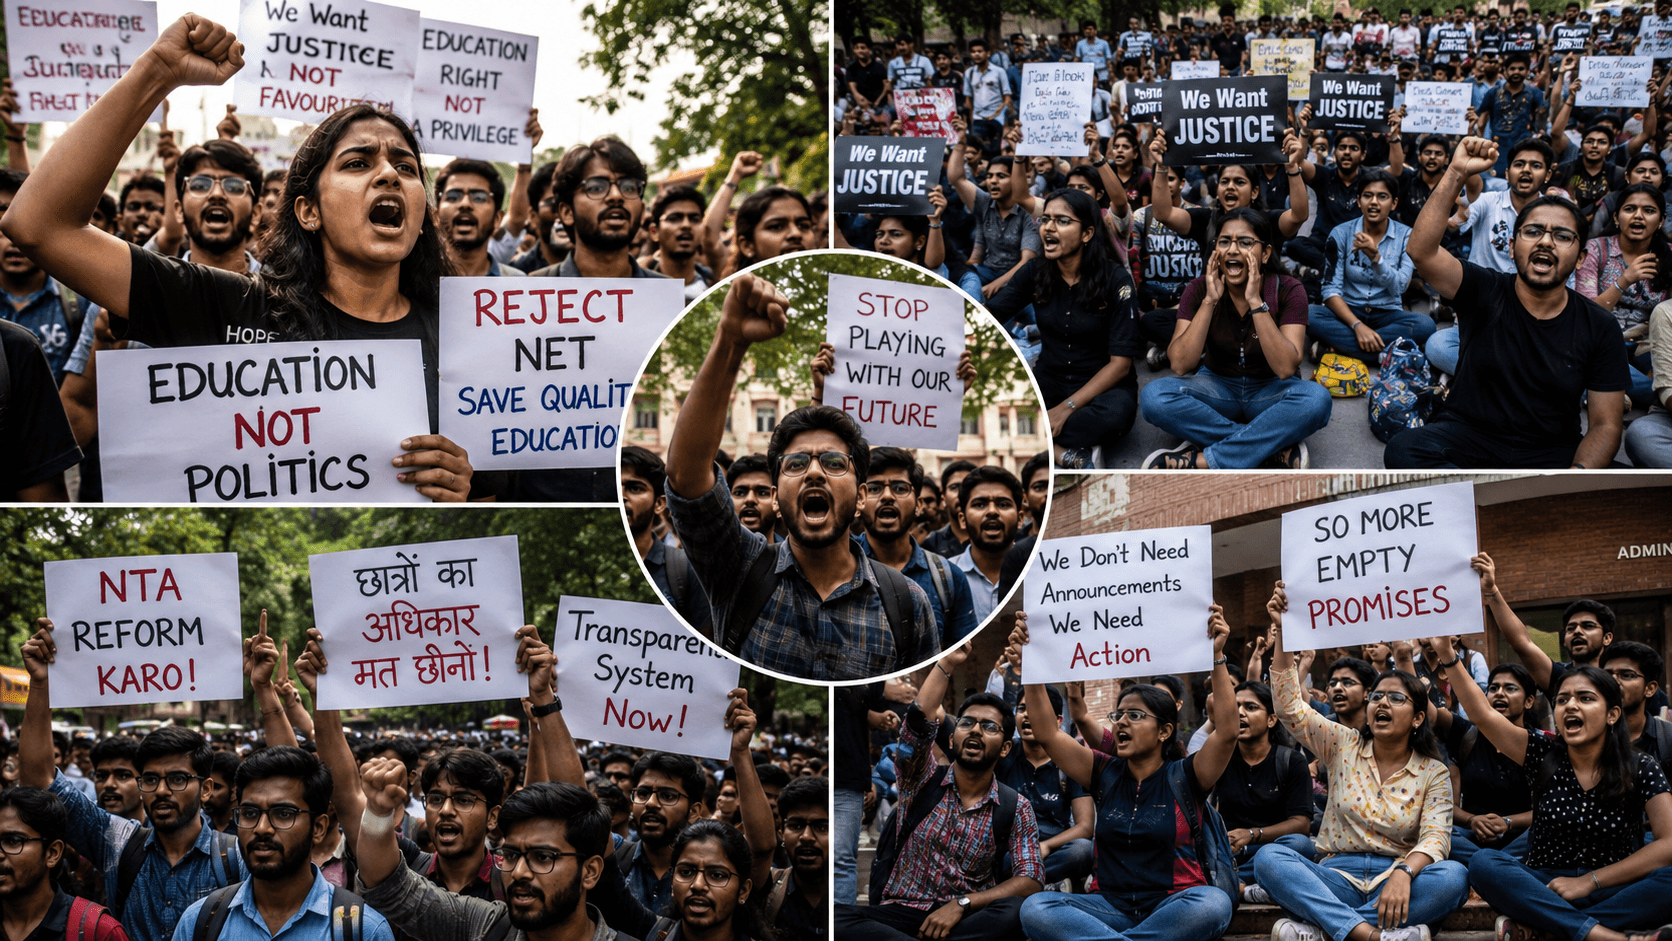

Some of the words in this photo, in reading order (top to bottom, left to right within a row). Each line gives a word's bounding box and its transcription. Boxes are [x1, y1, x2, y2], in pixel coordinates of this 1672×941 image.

[266, 0, 298, 22] We
[310, 3, 369, 32] Want
[423, 29, 528, 62] EDUCATION
[290, 62, 342, 87] NOT
[441, 64, 502, 90] RIGHT
[1322, 80, 1343, 94] We
[1346, 80, 1382, 96] Want
[445, 95, 486, 114] NOT
[1180, 90, 1210, 109] We
[1216, 87, 1268, 108] Want
[1315, 99, 1385, 119] JUSTICE
[412, 119, 423, 138] A
[431, 119, 519, 145] PRIVILEGE
[1174, 115, 1275, 145] JUSTICE
[849, 145, 876, 162] We
[881, 145, 927, 163] Want
[837, 169, 929, 195] JUSTICE
[474, 289, 633, 327] REJECT
[857, 292, 928, 321] STOP
[515, 336, 595, 372] NET
[849, 325, 946, 357] PLAYING
[846, 362, 901, 386] WITH
[912, 368, 952, 392] OUR
[458, 386, 526, 415] SAVE
[541, 378, 633, 413] QUALIT
[842, 396, 937, 428] FUTURE
[234, 406, 321, 450] NOT
[491, 421, 620, 455] EDUCATIO
[1314, 514, 1349, 543] SO
[1361, 501, 1434, 535] MORE
[1039, 549, 1070, 572] We
[1080, 543, 1129, 568] Don't
[1141, 538, 1189, 562] Need
[1317, 543, 1416, 583] EMPTY
[1617, 542, 1672, 560] ADMIN
[100, 568, 182, 604] NTA
[353, 551, 420, 597] छात्रों
[436, 558, 478, 589] का
[1040, 574, 1182, 605] Announcements
[362, 600, 481, 643] अधिकार
[1049, 612, 1081, 634] We
[1094, 606, 1143, 630] Need
[1307, 585, 1450, 629] PROMISES
[71, 617, 204, 652] REFORM
[568, 610, 729, 659] Transparen
[1070, 641, 1151, 669] Action
[97, 658, 196, 696] KARO!
[351, 657, 400, 689] मत
[594, 653, 694, 694] System
[603, 697, 687, 737] Now!
